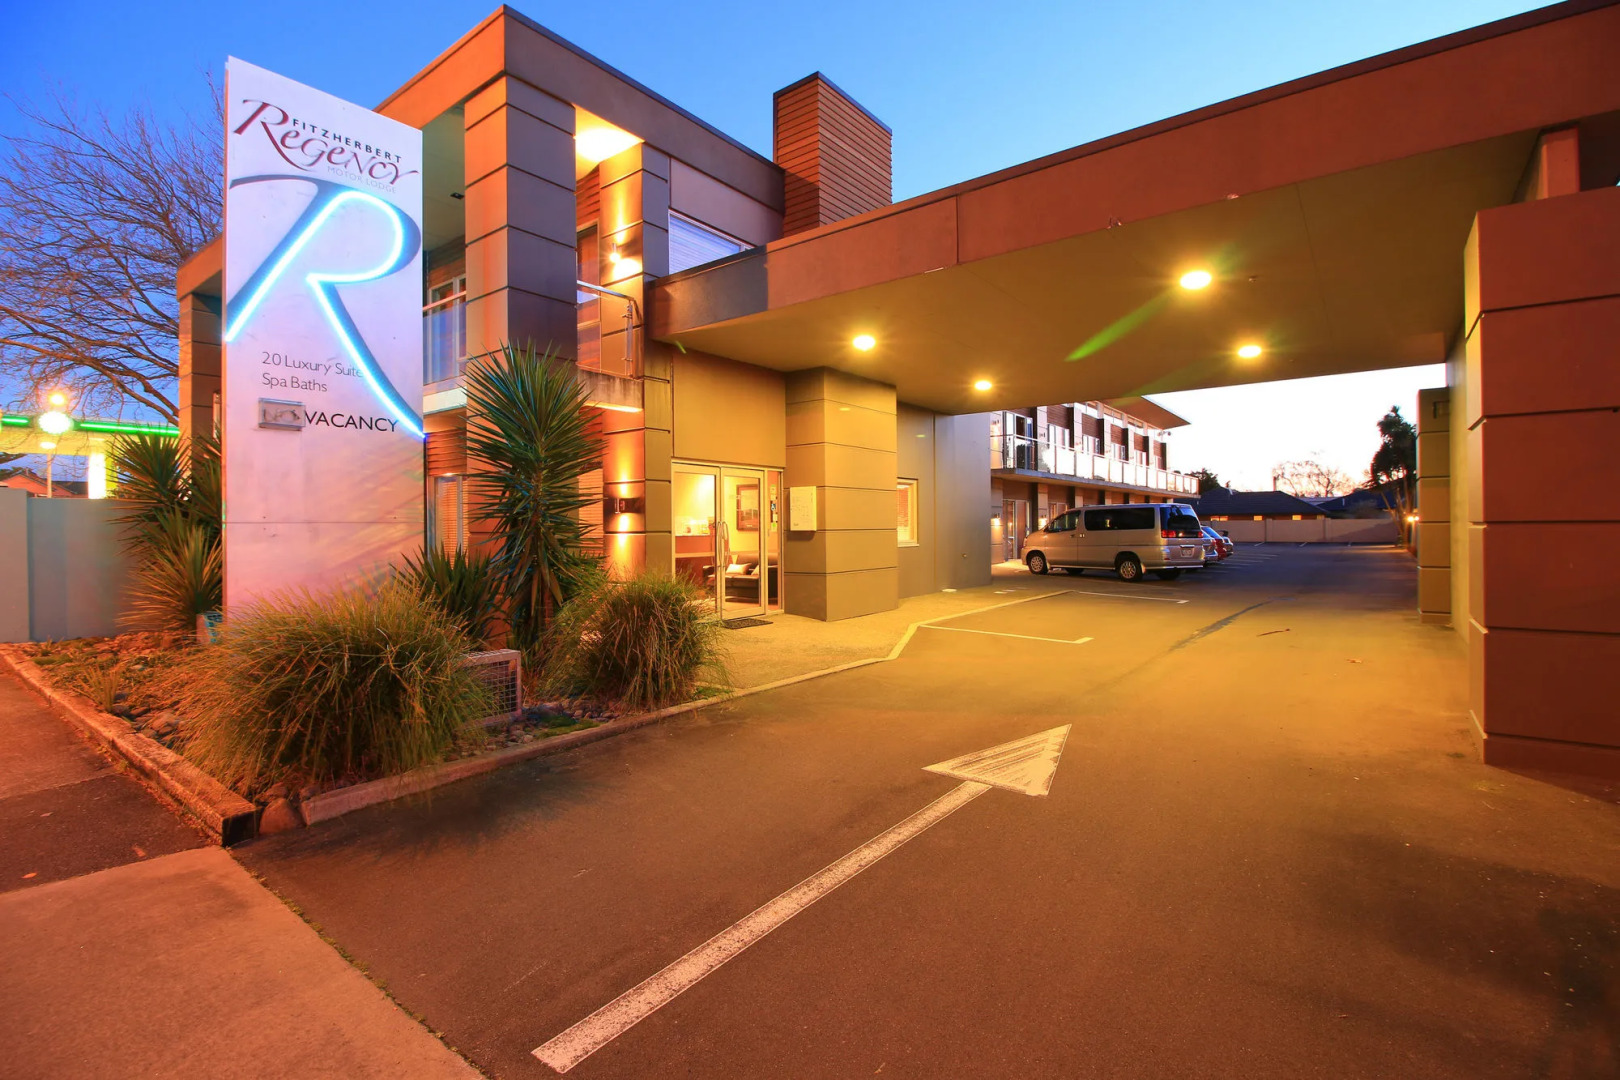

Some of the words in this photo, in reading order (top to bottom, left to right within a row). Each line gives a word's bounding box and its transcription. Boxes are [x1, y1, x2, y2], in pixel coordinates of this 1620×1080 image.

[293, 118, 402, 163] FITZHERBERT
[327, 165, 362, 182] MOTOR
[366, 177, 397, 194] LODGE
[262, 351, 282, 366] 20
[285, 355, 331, 376] Luxury
[335, 362, 364, 378] Suite
[262, 372, 288, 390] Spa
[291, 376, 328, 392] Baths
[304, 410, 399, 432] VACANCY
